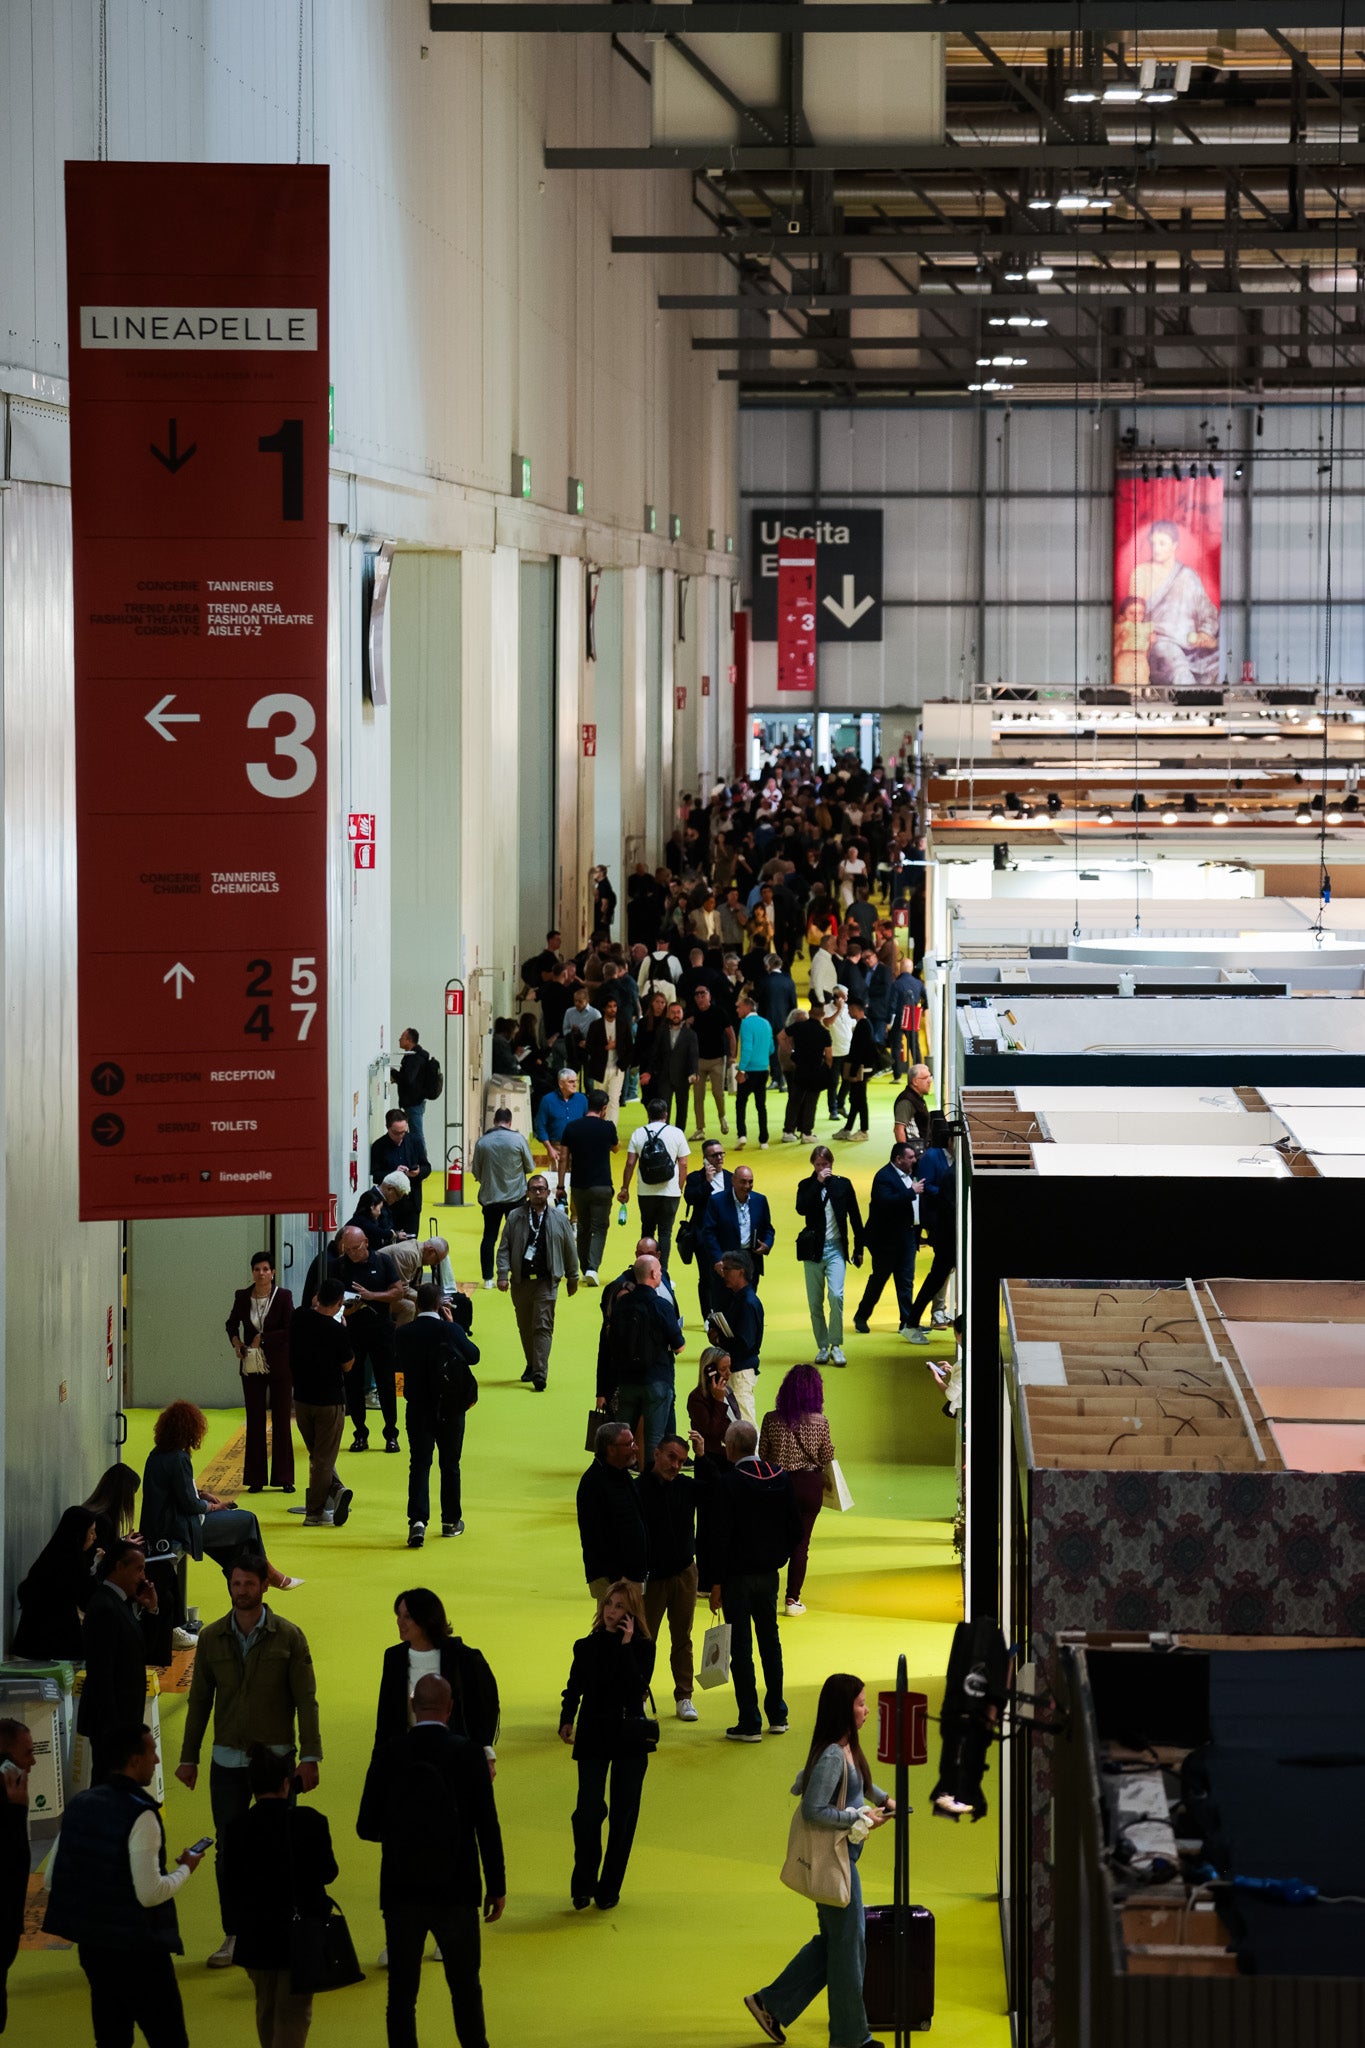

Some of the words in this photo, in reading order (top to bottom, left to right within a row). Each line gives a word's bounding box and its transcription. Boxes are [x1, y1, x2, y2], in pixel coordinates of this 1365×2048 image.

[91, 316, 306, 341] LINEAPELLE
[258, 419, 304, 522] 1
[761, 520, 850, 544] Uscita
[207, 581, 274, 592] TANNERIES
[207, 603, 248, 613] TREND
[251, 603, 281, 613] AREA
[207, 614, 260, 625] FASHION
[263, 614, 314, 625] THEATRE
[801, 614, 815, 631] 3
[207, 626, 241, 636] AISLE
[243, 626, 262, 636] V-Z
[245, 693, 318, 799] 3
[211, 872, 276, 882] TANNERIES
[211, 882, 280, 894] CHEMICALS
[246, 959, 273, 997] 2
[290, 957, 318, 996] 5
[244, 1004, 274, 1042] 4
[290, 1002, 318, 1041] 7
[210, 1069, 276, 1082] RECEPTION
[210, 1120, 258, 1132] TOILETS
[219, 1170, 273, 1183] lineapelle
